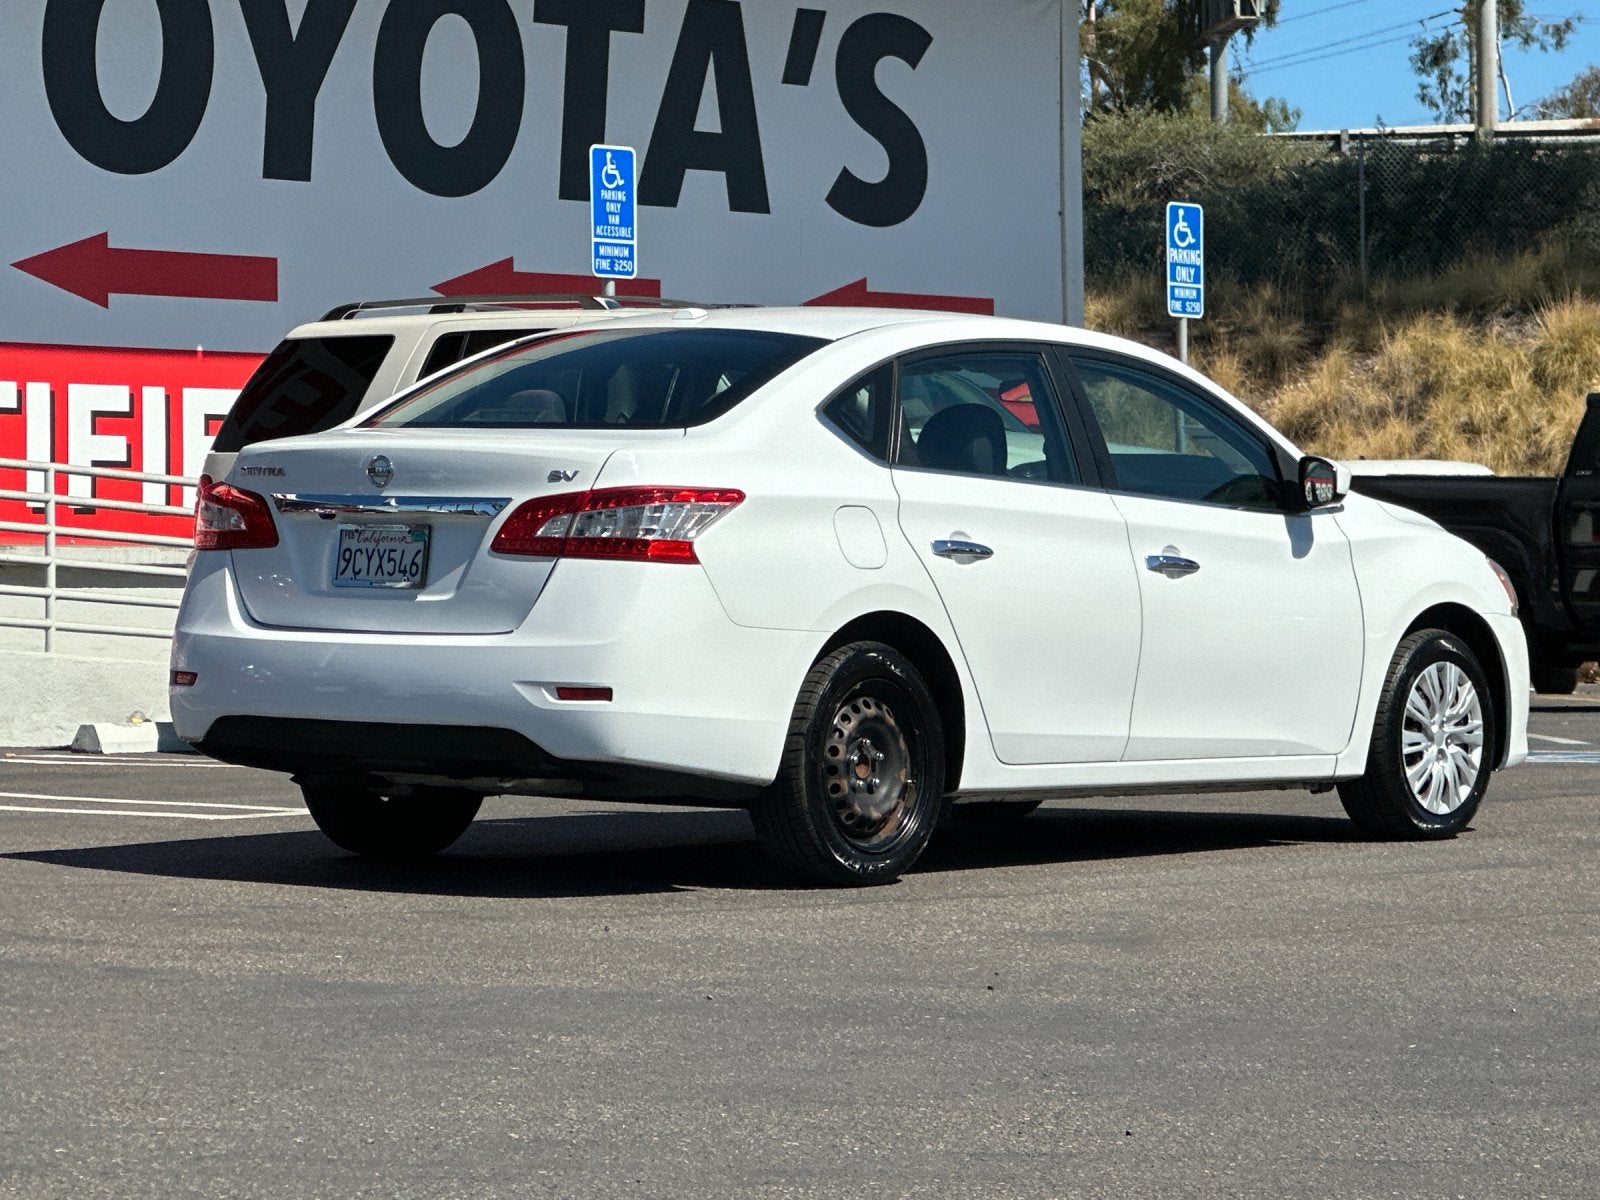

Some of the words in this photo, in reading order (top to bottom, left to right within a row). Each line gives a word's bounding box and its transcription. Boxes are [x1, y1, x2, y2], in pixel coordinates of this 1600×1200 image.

[42, 0, 933, 228] OYOTA'S
[600, 189, 626, 202] PARKING
[605, 202, 622, 213] ONLY
[608, 214, 620, 225] VAN
[595, 225, 632, 238] ACCESSIBLE
[599, 245, 629, 258] MINIMUM
[1169, 248, 1200, 266] PARKING
[595, 259, 611, 271] FINE
[614, 259, 633, 272] $250
[1176, 265, 1195, 283] ONLY
[1170, 300, 1183, 312] FINE
[0, 381, 242, 512] IFI
[547, 470, 580, 483] SV
[356, 529, 413, 548] California
[340, 547, 422, 578] 9CYX546
